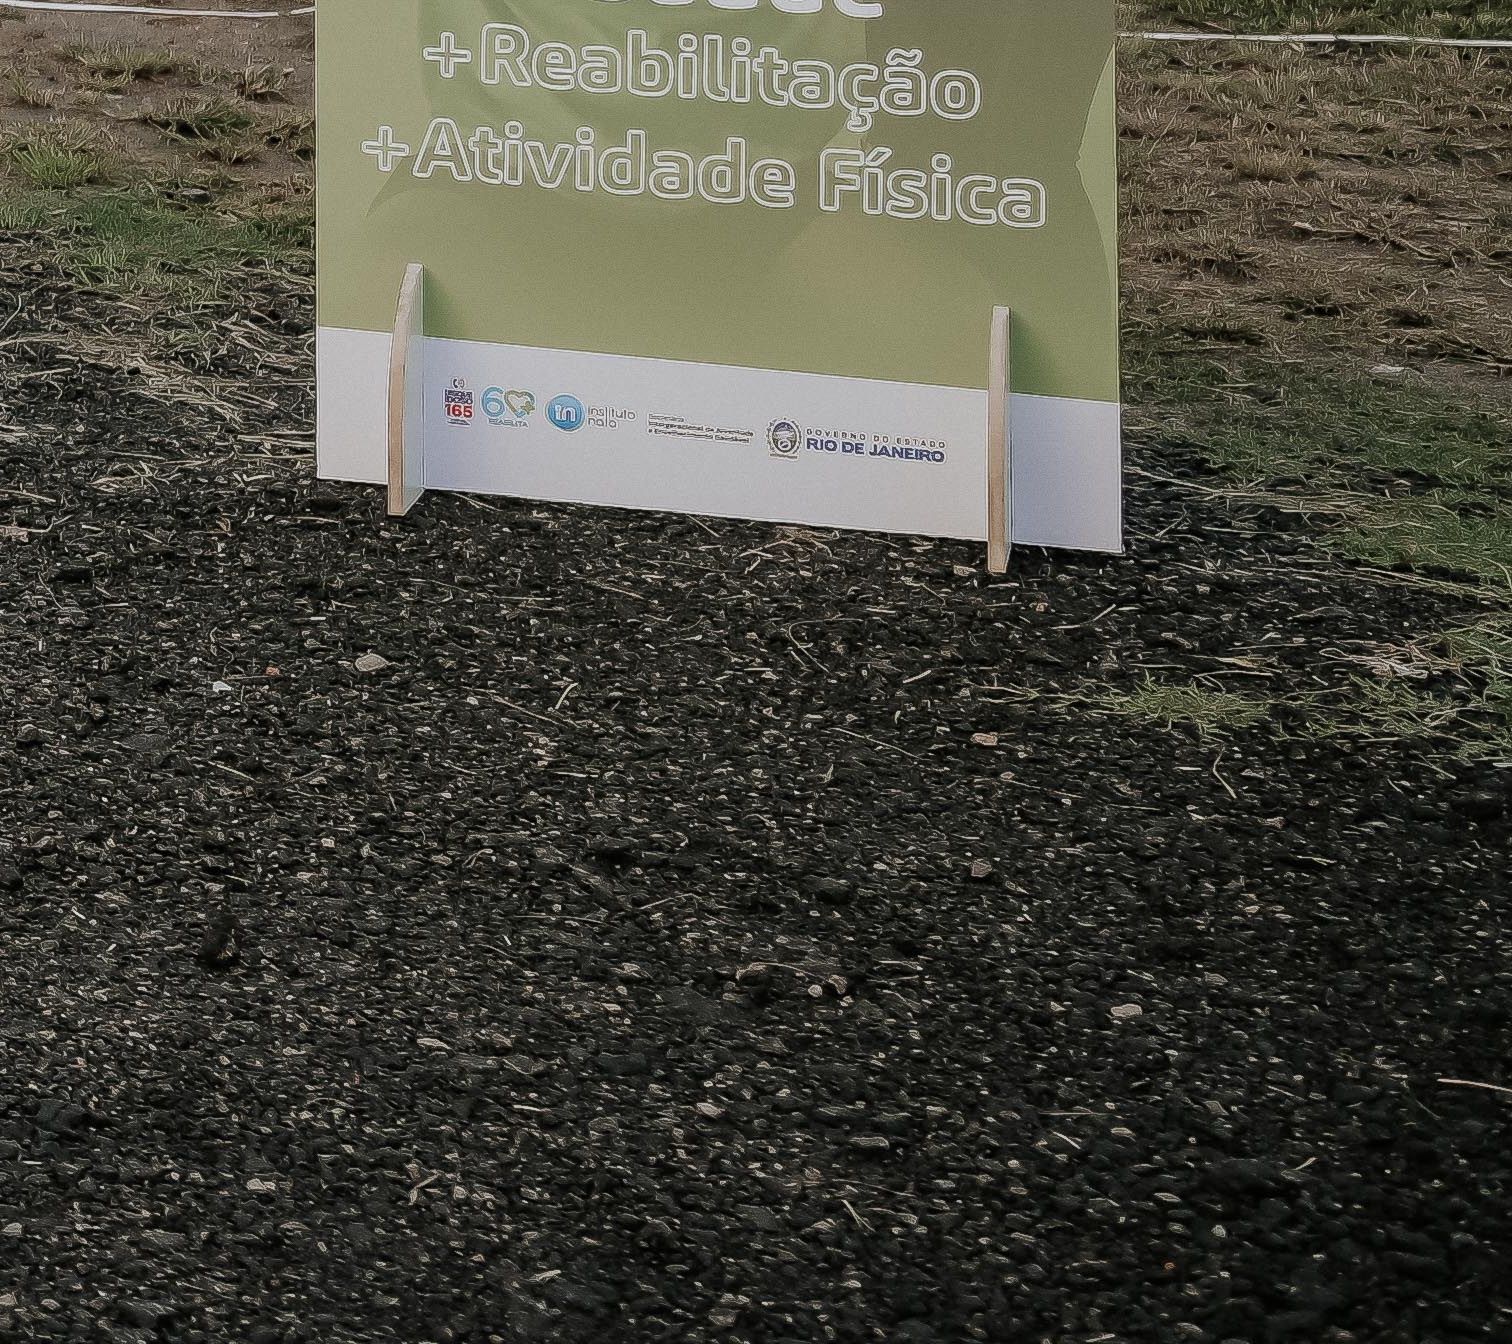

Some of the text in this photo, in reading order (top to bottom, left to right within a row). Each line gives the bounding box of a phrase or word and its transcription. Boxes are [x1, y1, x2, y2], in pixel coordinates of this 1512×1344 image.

[818, 146, 1049, 229] Física
[445, 403, 473, 419] 165
[806, 428, 866, 441] GOVERNO
[896, 437, 946, 449] ESTADO
[806, 438, 945, 463] RIO DE JANEIRO
